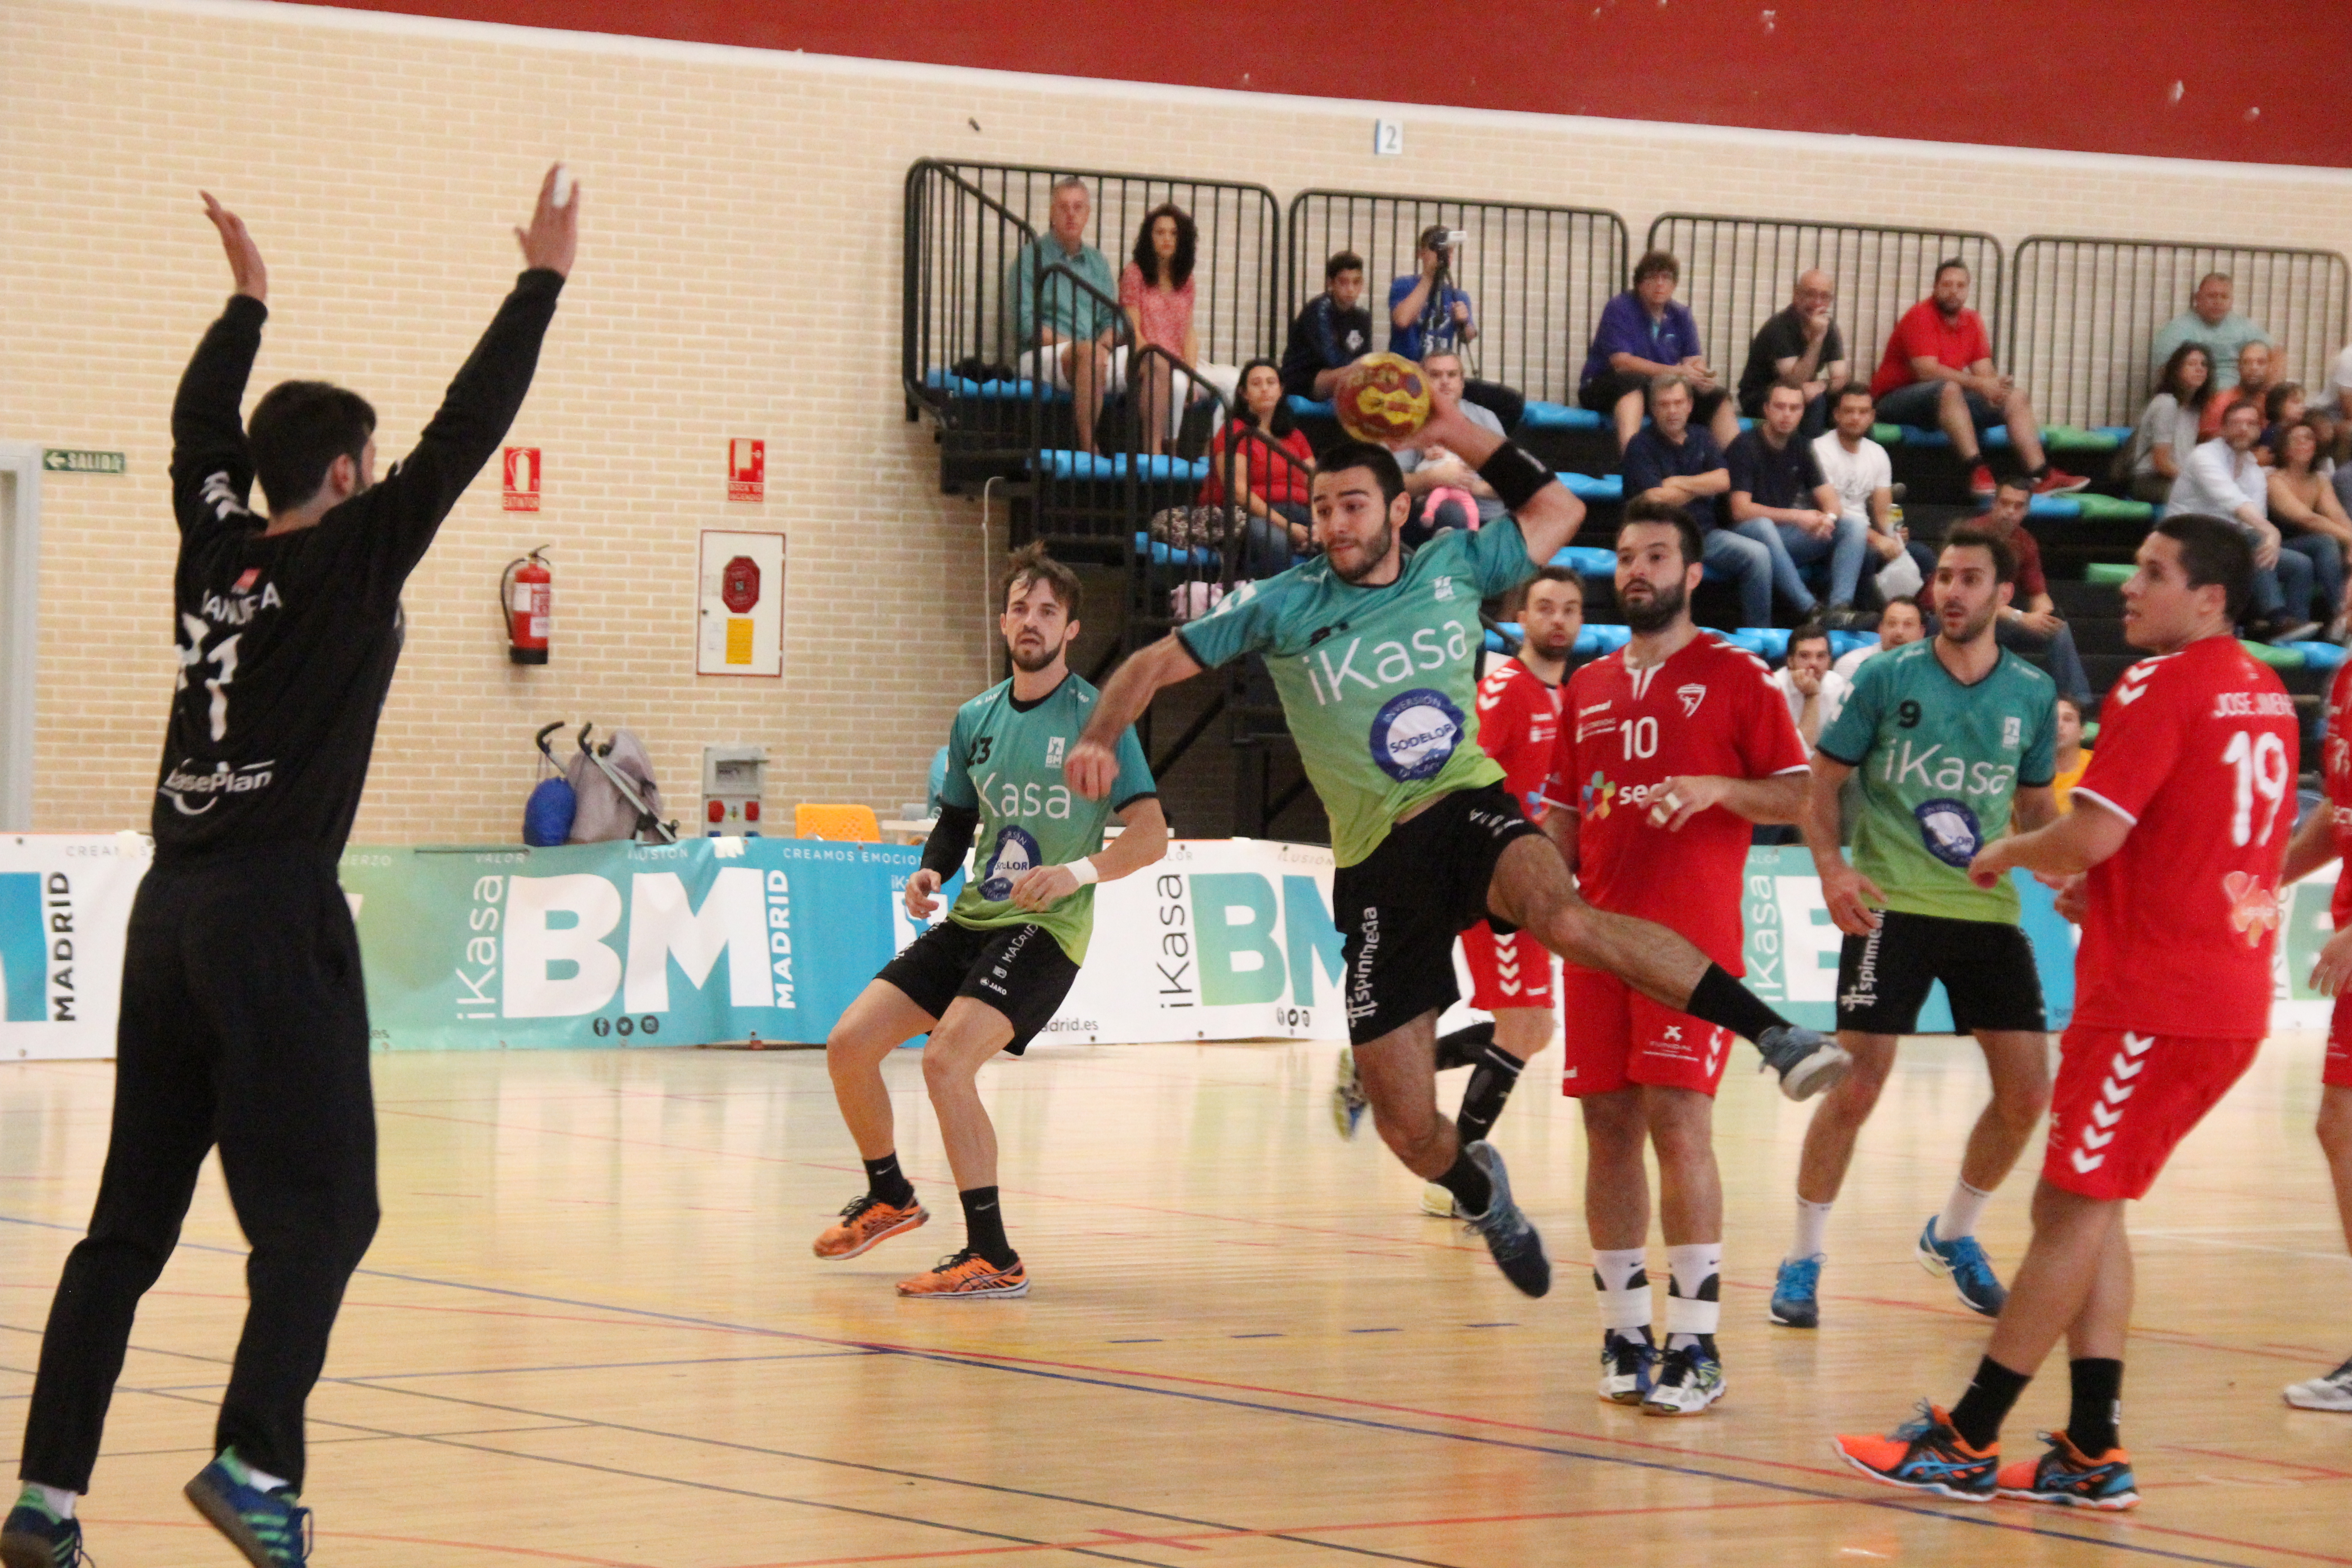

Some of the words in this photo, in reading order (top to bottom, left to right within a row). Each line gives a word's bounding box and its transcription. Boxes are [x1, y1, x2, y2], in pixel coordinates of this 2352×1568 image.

[1386, 125, 1397, 149] 2
[1302, 619, 1468, 706] iKasa
[1390, 723, 1454, 753] SODELOR
[1619, 715, 1659, 761] 10
[1898, 699, 1921, 729] 9
[1884, 739, 2015, 795] iKasa
[2221, 730, 2289, 847] 19
[783, 848, 855, 862] CREAMOS
[47, 871, 77, 1022] MADRID
[455, 874, 504, 1019] iKasa
[503, 866, 775, 1018] BM
[767, 869, 796, 1009] MADRID
[1002, 924, 1039, 963] MADRID
[1156, 873, 1194, 1009] iKasa
[1188, 872, 1349, 1007] BM
[989, 982, 1007, 995] JAKO
